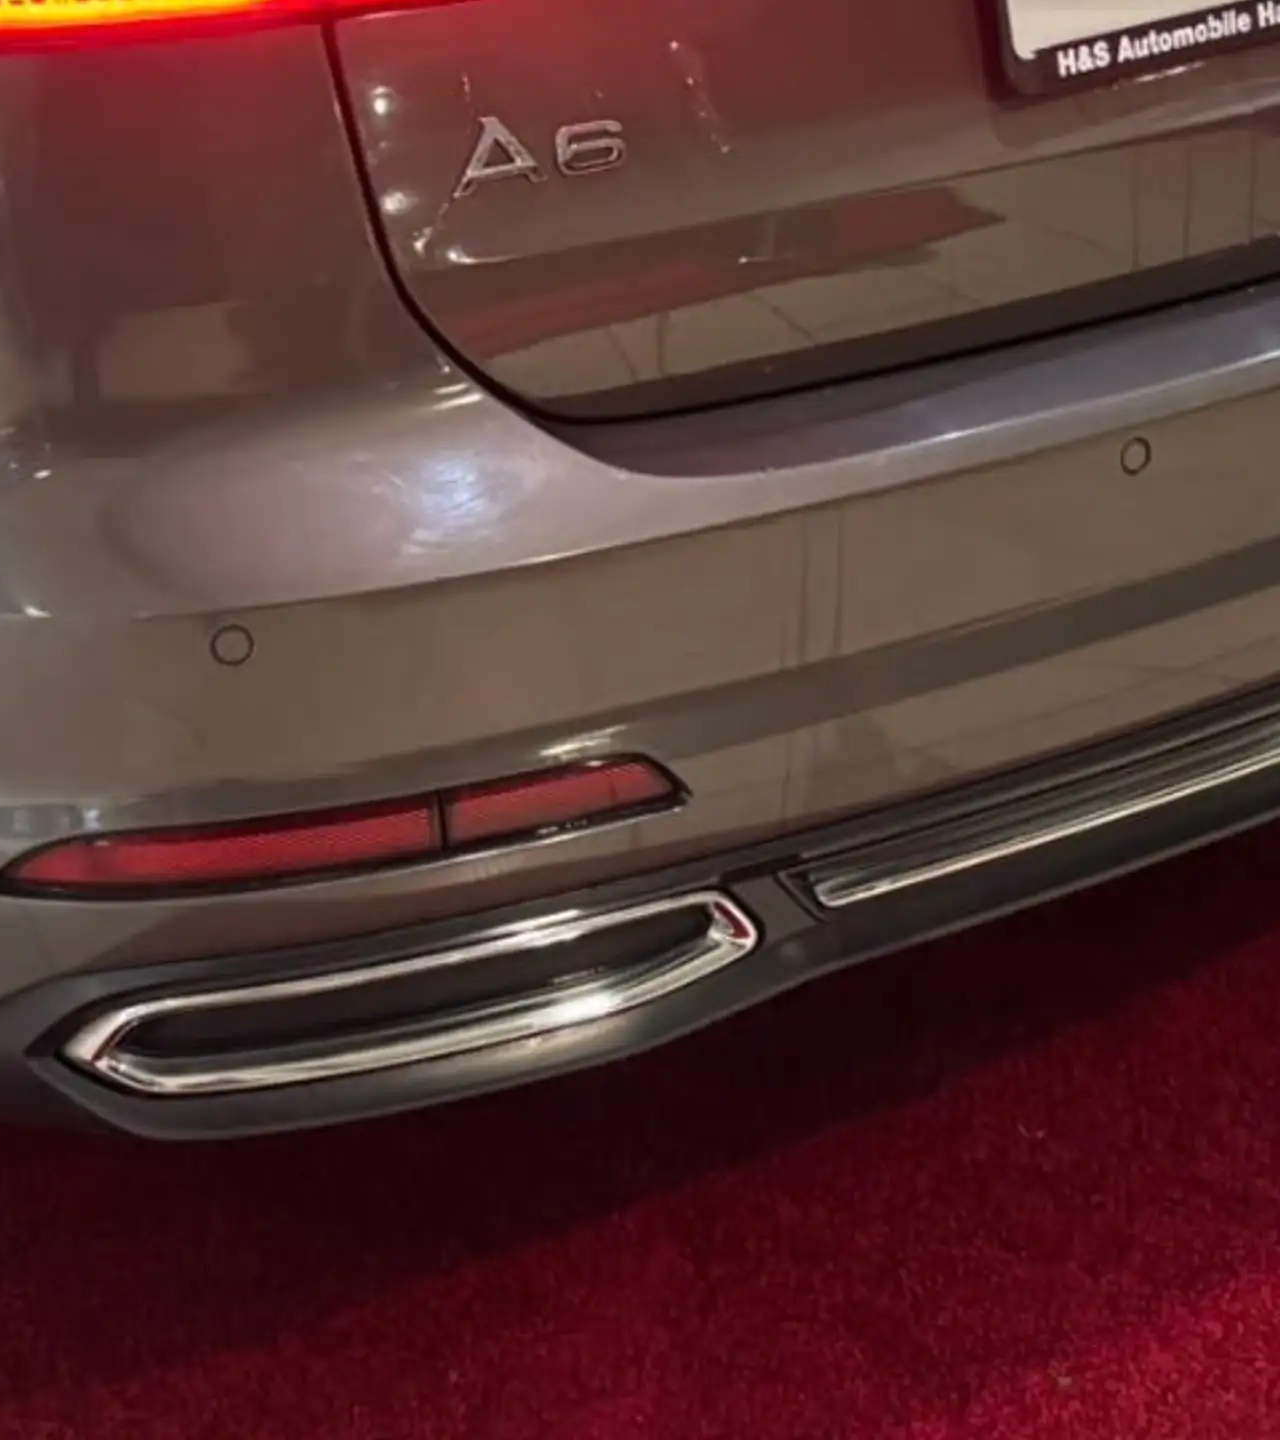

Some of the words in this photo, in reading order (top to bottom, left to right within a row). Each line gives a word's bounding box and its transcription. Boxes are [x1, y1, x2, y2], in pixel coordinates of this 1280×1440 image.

[1056, 40, 1111, 79] H&S
[1117, 10, 1252, 63] Automobile
[453, 116, 627, 199] A6
